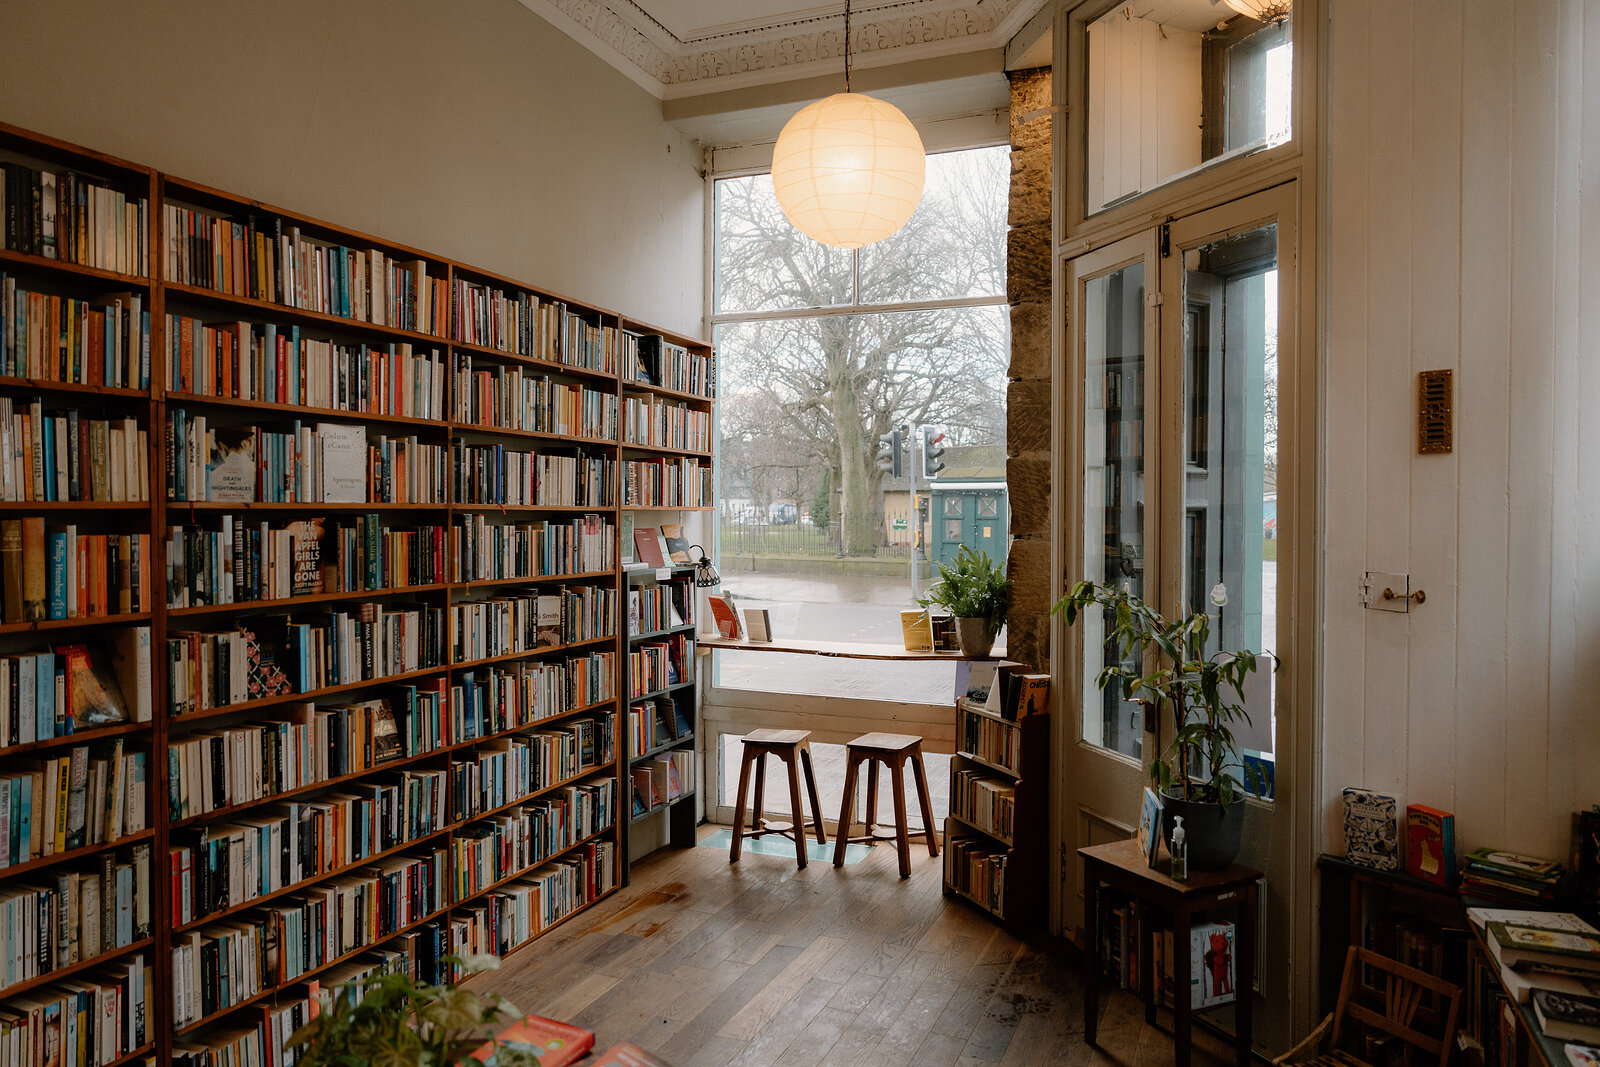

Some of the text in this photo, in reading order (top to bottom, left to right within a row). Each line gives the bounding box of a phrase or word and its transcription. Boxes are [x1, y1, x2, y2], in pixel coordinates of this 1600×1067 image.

[300, 520, 315, 530] THE
[297, 530, 317, 540] VAN
[52, 540, 63, 562] Philip
[295, 541, 320, 551] APFEL
[295, 551, 320, 561] GIRLS
[299, 561, 316, 571] ARE
[294, 571, 320, 582] GONE
[74, 750, 83, 787] IGGULDEN
